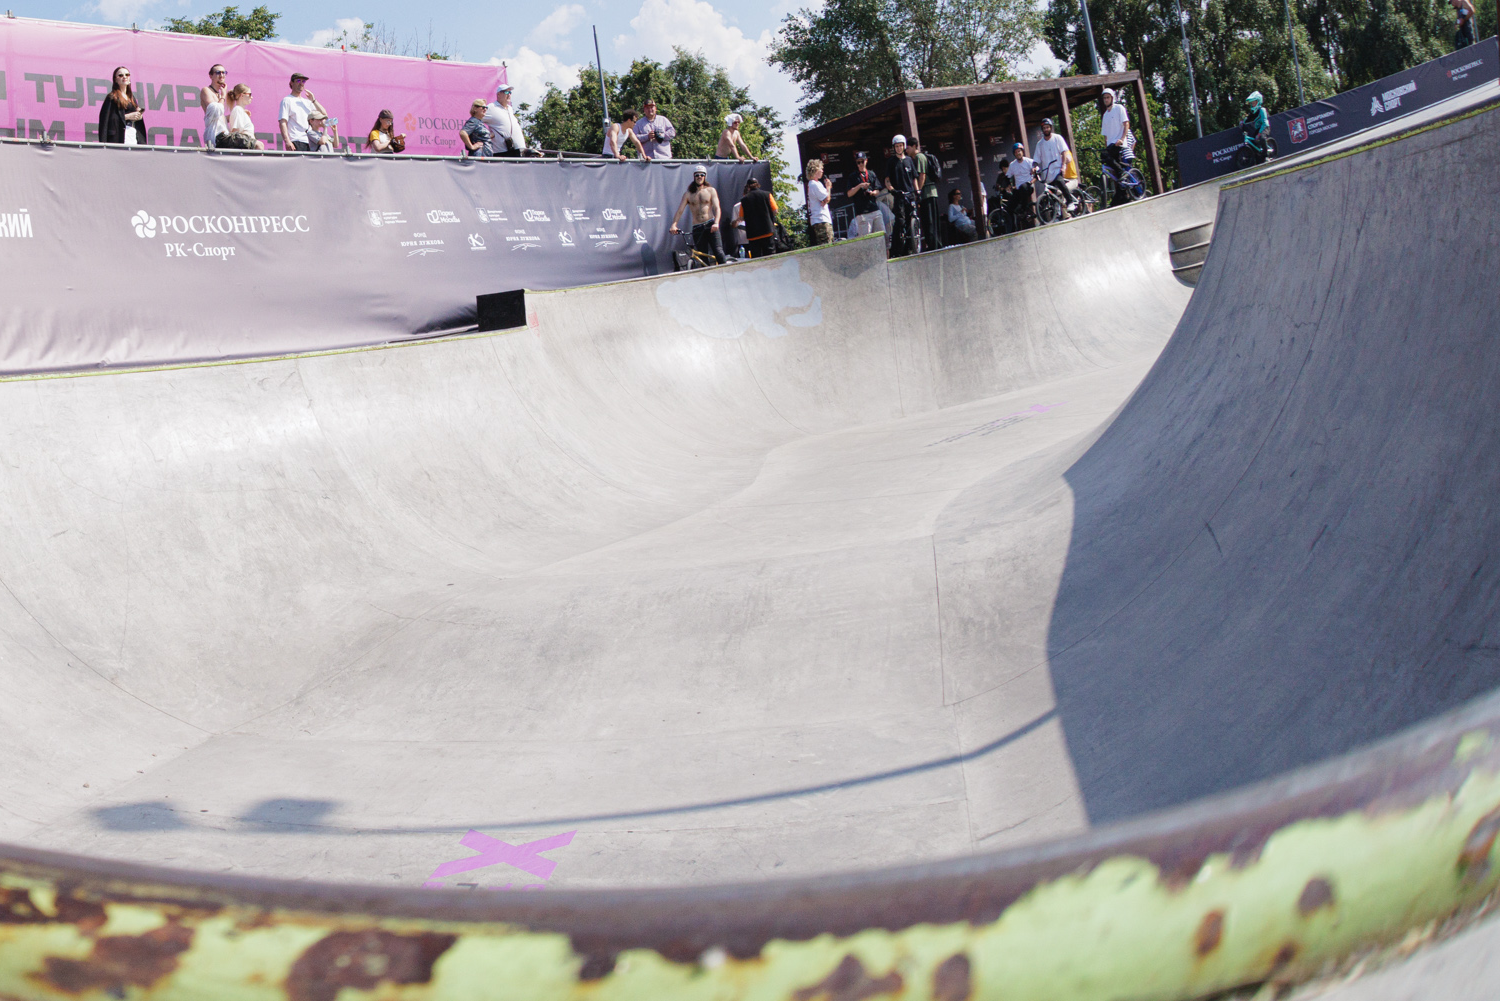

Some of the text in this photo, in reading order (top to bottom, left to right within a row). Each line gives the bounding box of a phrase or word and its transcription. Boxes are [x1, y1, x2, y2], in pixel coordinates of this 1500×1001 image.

[418, 117, 465, 131] РОСКОН
[158, 214, 310, 235] РОСКОНГРЕСС
[164, 242, 236, 261] РК-Спорт
